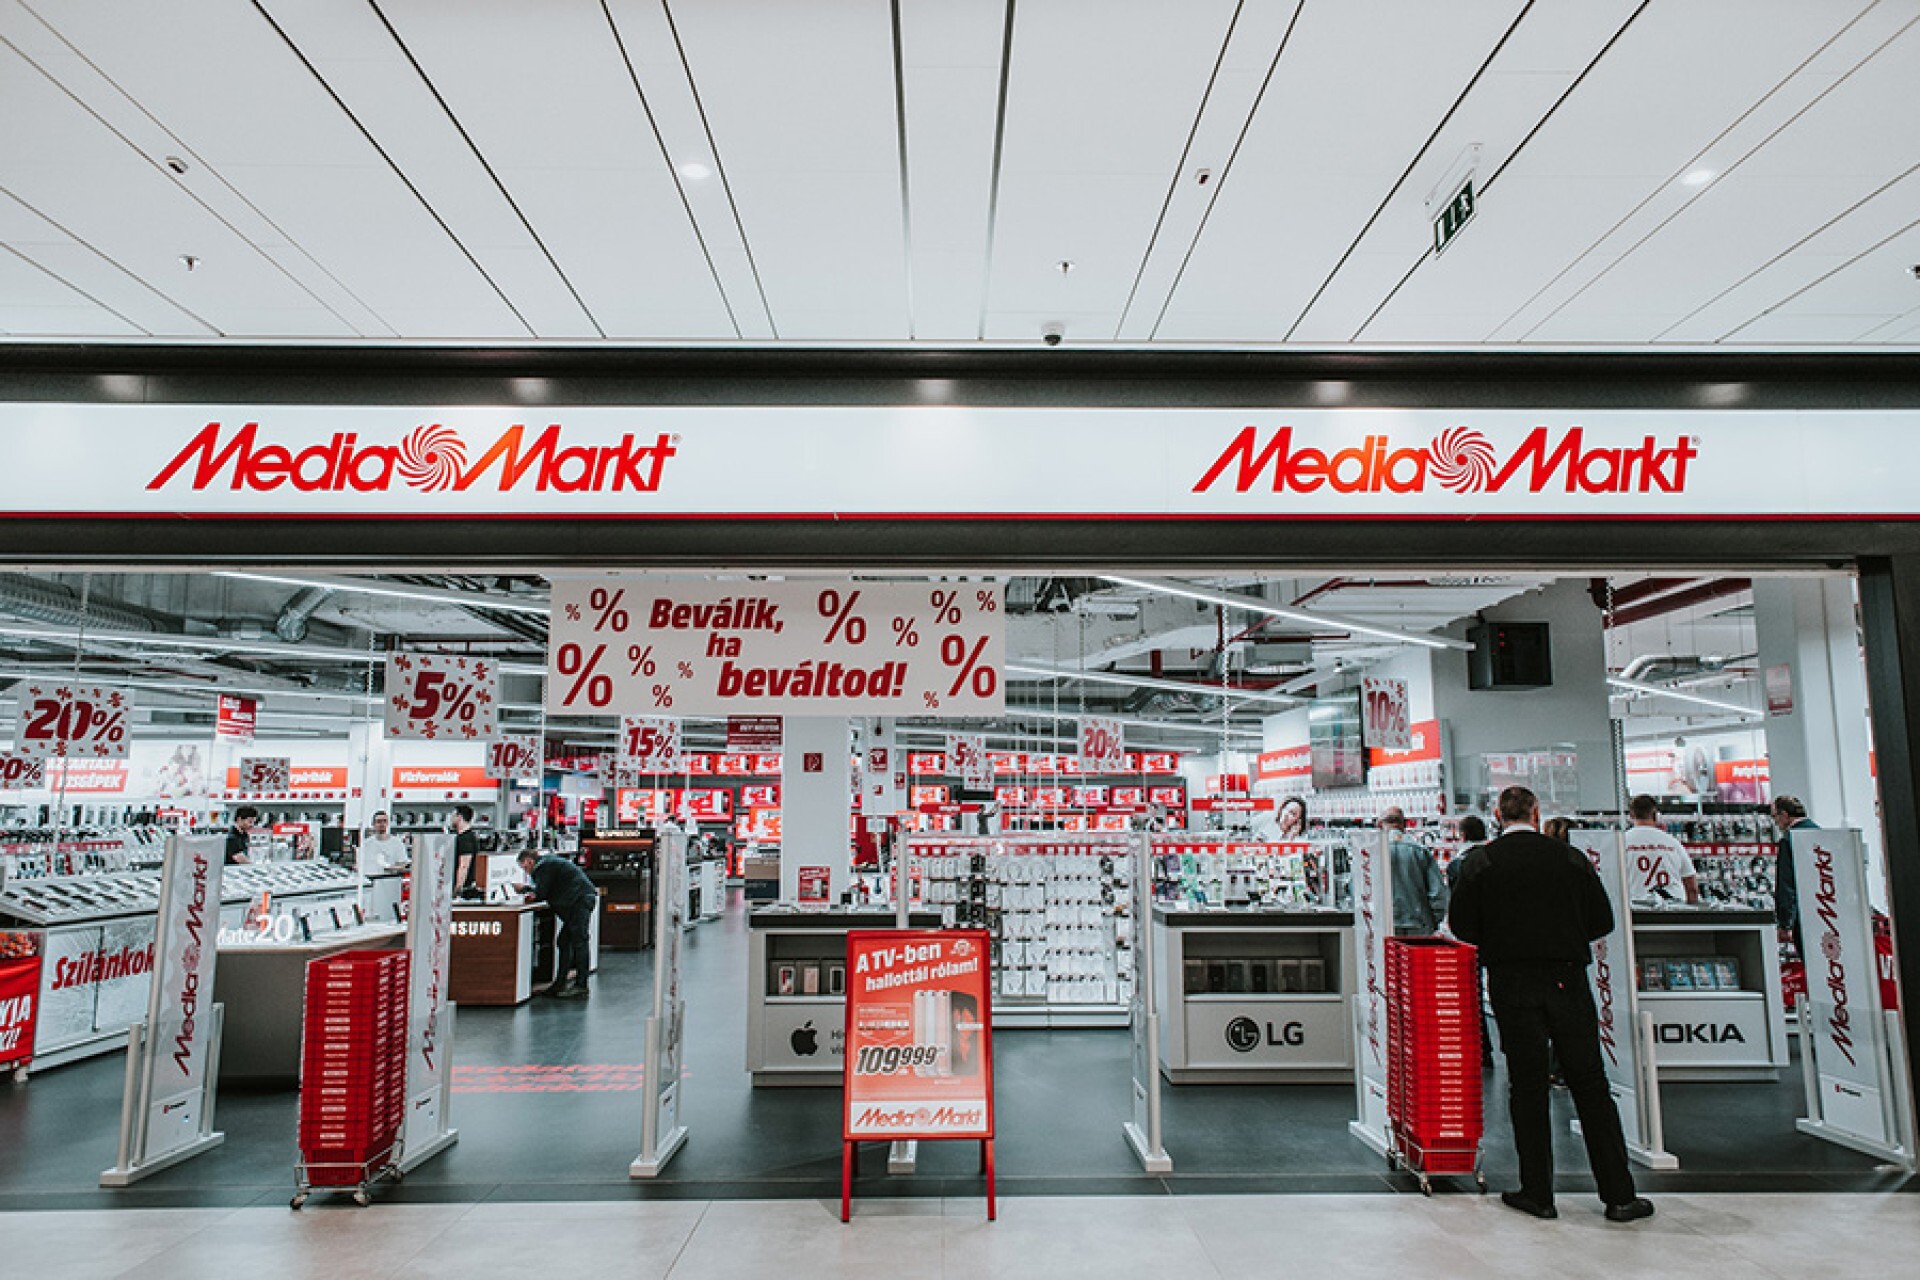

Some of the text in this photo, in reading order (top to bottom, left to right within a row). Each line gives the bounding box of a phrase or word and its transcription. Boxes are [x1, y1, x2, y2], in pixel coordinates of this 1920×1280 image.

[145, 422, 677, 492] Media Markt
[1192, 425, 1697, 493] Media Markt
[648, 597, 785, 635] Beválik,
[705, 632, 742, 658] ha
[409, 671, 476, 721] 5%
[716, 660, 908, 698] beváltod!
[24, 698, 124, 743] 20%
[1366, 690, 1405, 733] 10%
[492, 742, 536, 769] 10%
[628, 726, 673, 758] 15%
[1083, 726, 1121, 760] 20%
[251, 763, 280, 784] 5%
[257, 912, 294, 943] 20
[856, 942, 942, 973] A TV-ben
[1266, 1021, 1304, 1046] LG
